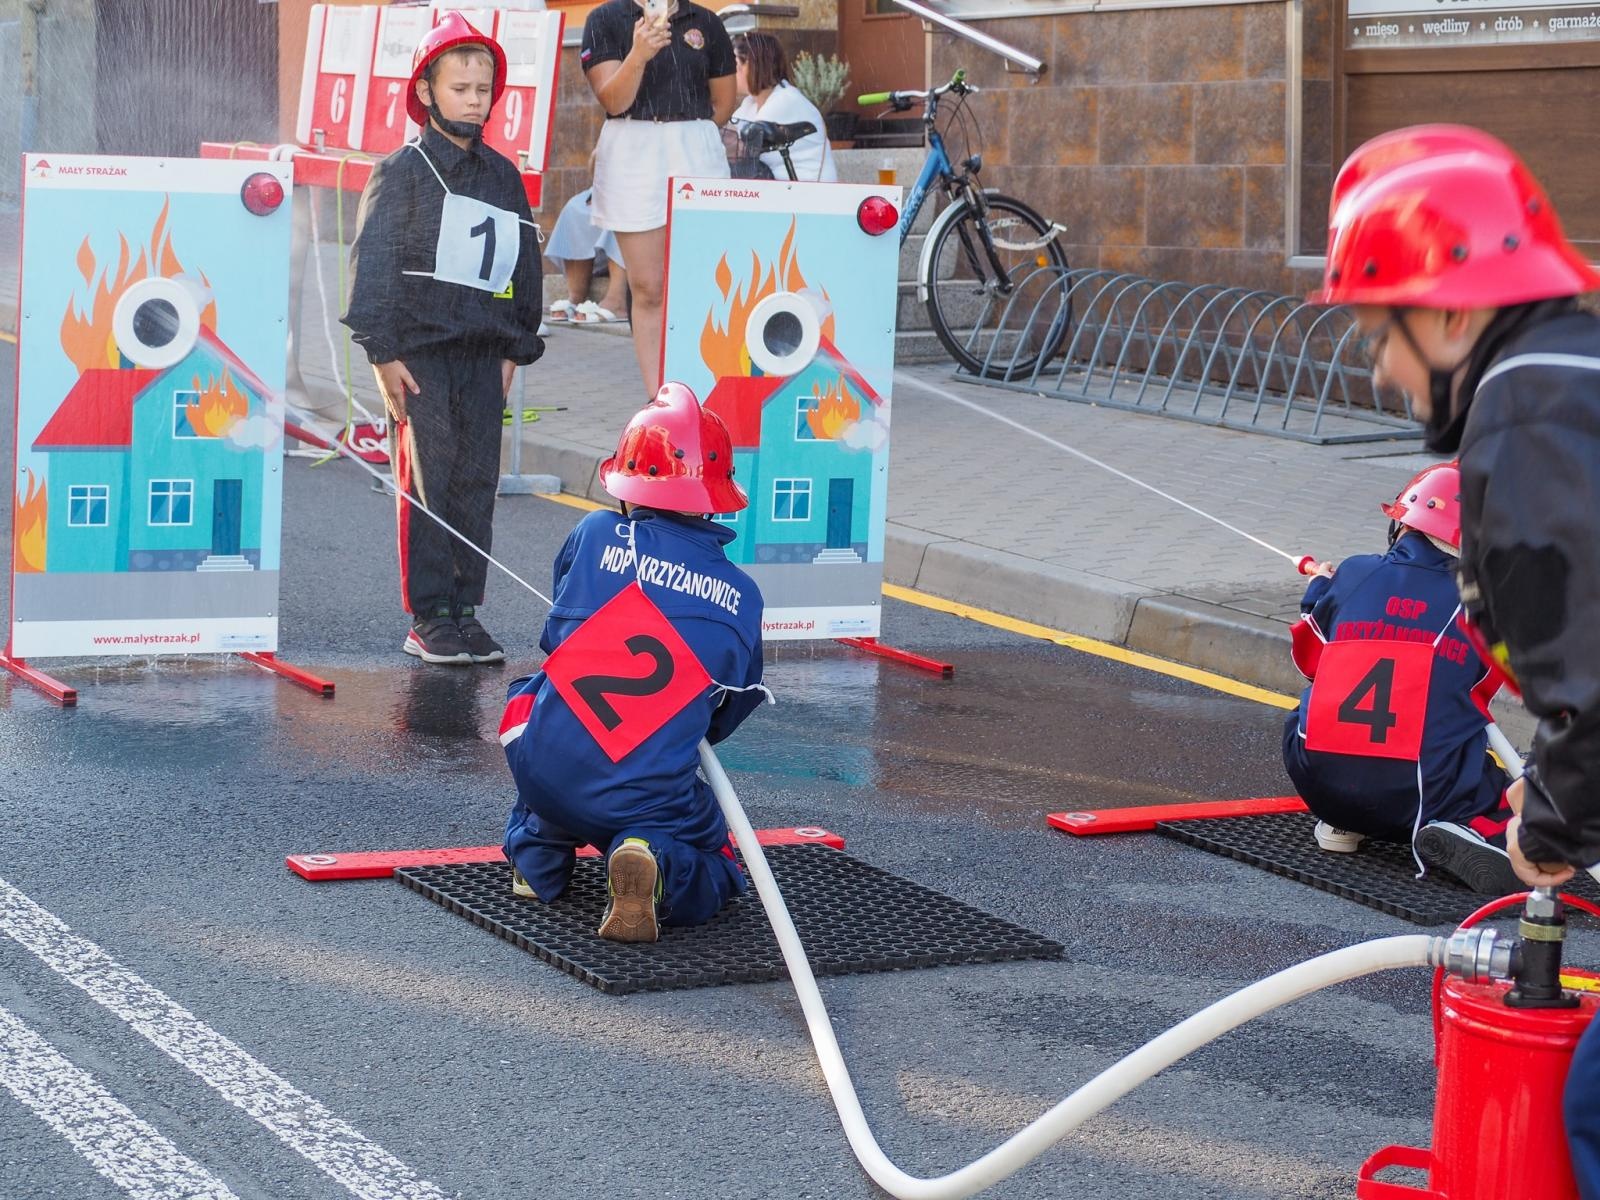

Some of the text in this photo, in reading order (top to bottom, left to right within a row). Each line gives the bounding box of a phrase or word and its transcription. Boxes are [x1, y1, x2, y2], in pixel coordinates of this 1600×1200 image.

[1366, 21, 1399, 38] mięso
[1423, 17, 1470, 36] wędliny
[1494, 16, 1523, 32] drób
[330, 78, 346, 124] 6
[386, 82, 401, 129] 7
[503, 90, 522, 141] 9
[58, 165, 128, 176] MAŁY STRAŻAK
[701, 189, 760, 199] MAŁY STRAŻAK
[470, 215, 497, 281] 1
[600, 545, 742, 616] MDP KRZYŻANOWICE
[763, 620, 815, 632] lystrazak.pl
[1385, 595, 1428, 620] OSP
[93, 632, 201, 645] www.malystrazak.pl
[570, 634, 675, 732] 2
[1338, 657, 1397, 744] 4
